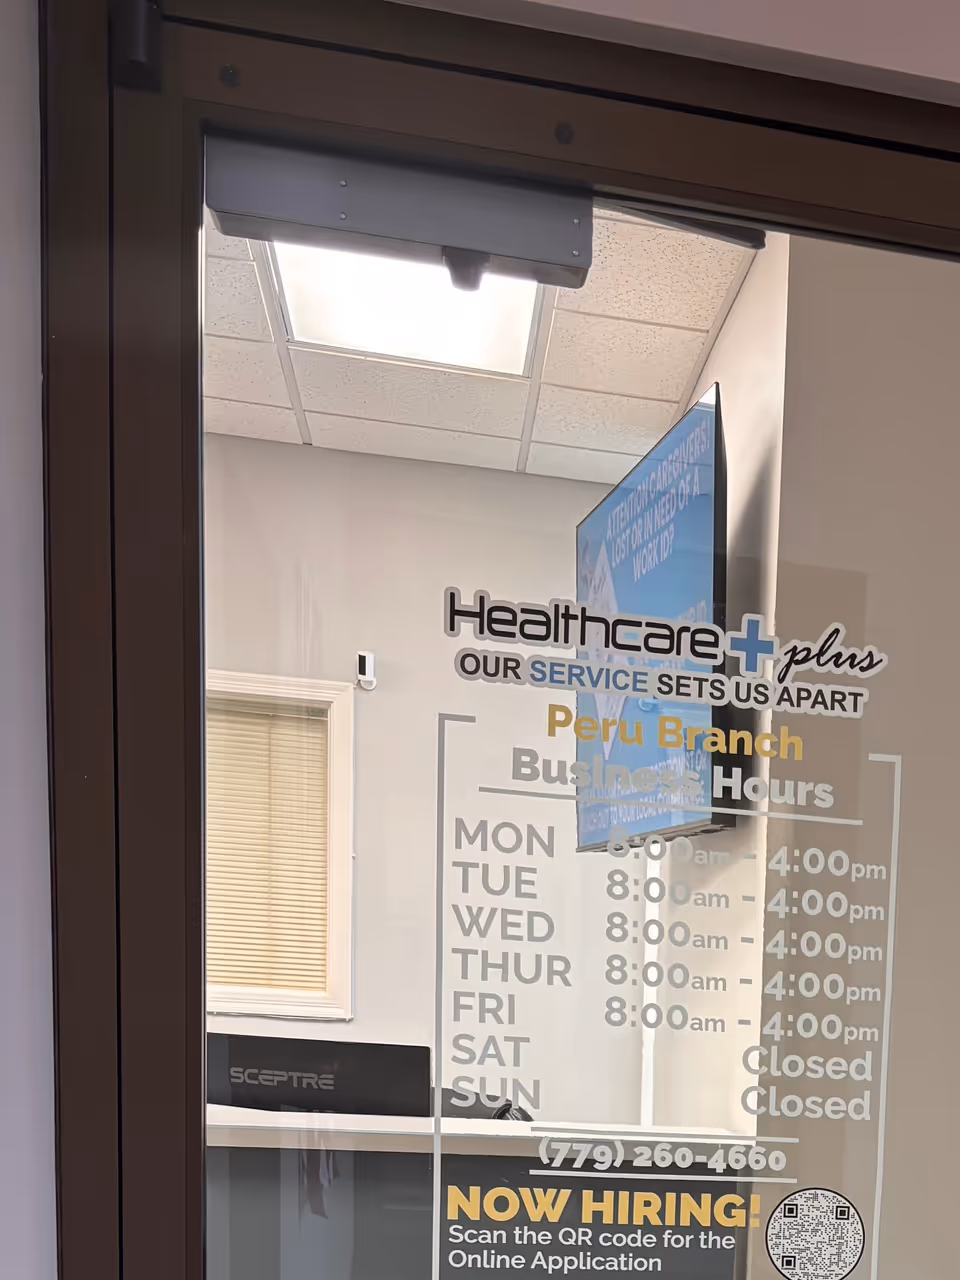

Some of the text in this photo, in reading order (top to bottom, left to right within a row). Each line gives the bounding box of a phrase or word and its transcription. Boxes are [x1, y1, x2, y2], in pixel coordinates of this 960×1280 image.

[606, 416, 711, 541] ATTENTION CAREGIVERS!
[611, 465, 700, 568] LOST OR IN NEED OF A
[632, 522, 675, 583] WORK ID?
[448, 590, 720, 661] Healthcare
[777, 626, 885, 683] plus
[459, 651, 522, 681] OUR
[529, 659, 649, 694] SERVICE
[656, 672, 727, 701] SETS
[734, 680, 771, 705] US
[775, 686, 865, 714] APART
[547, 703, 804, 761] Peru Branch
[511, 746, 703, 799] Business
[713, 765, 835, 810] Hours
[454, 817, 555, 859] MON
[768, 845, 887, 881] 4:00pm
[451, 860, 538, 901] TUE
[605, 868, 731, 910] 8:00am
[766, 887, 885, 923] 4:00pm
[451, 903, 556, 943] WED
[604, 911, 730, 951] 8:00am
[765, 930, 884, 964] 4:00pm
[450, 947, 573, 988] THUR
[604, 953, 728, 992] 8:00am
[763, 970, 882, 1005] 4:00pm
[452, 990, 517, 1026] FRI
[603, 995, 726, 1034] 8:00am
[761, 1011, 880, 1046] 4:00pm
[229, 1066, 335, 1091] SCEPTRE
[450, 1033, 874, 1083] SAT Closed
[449, 1075, 872, 1122] SUN Closed
[537, 1136, 788, 1174] (779) 260-4660
[446, 1184, 762, 1229] NOW HIRING!
[447, 1224, 736, 1251] Scan the QR code for the
[447, 1249, 663, 1275] Online Application
